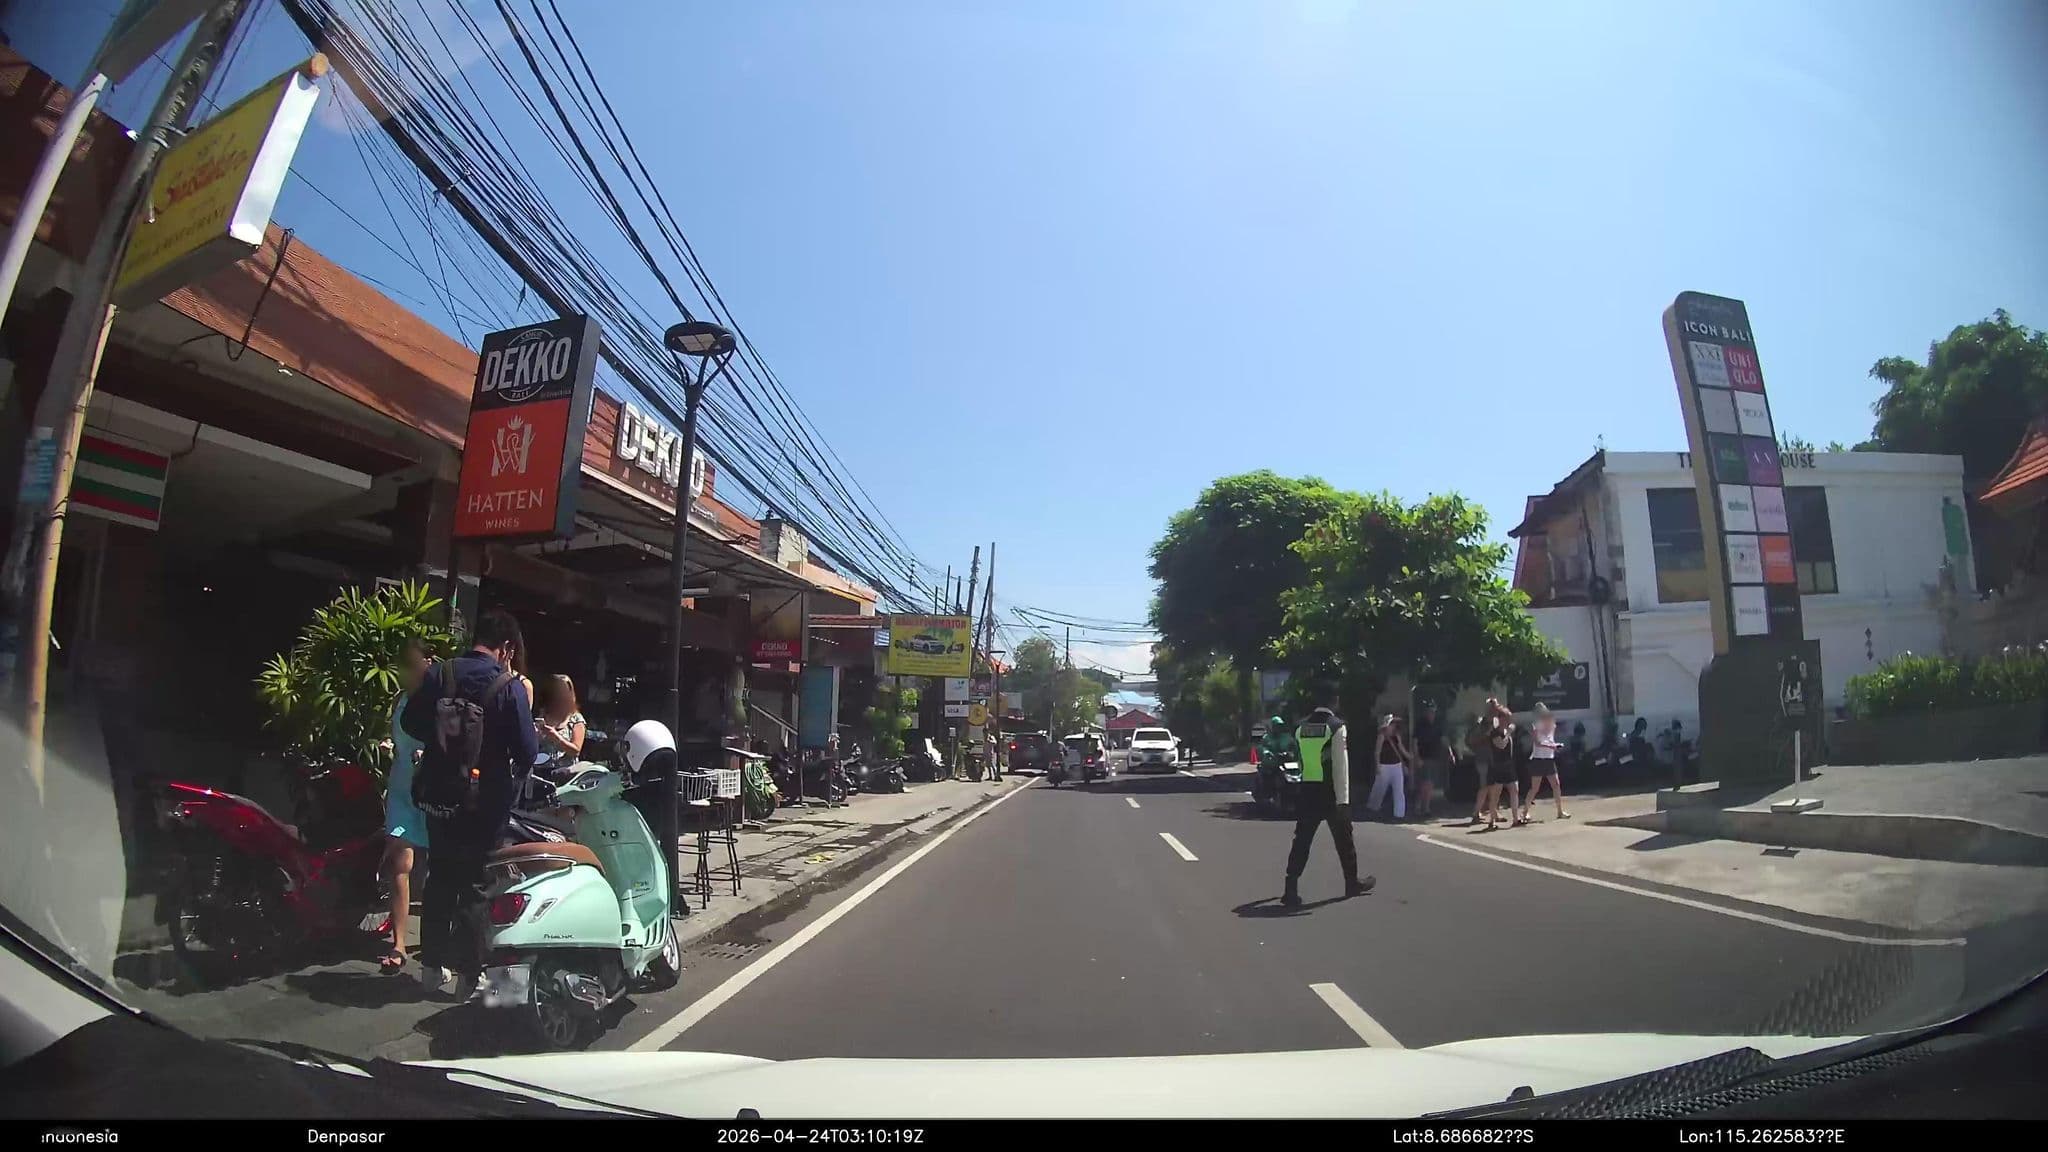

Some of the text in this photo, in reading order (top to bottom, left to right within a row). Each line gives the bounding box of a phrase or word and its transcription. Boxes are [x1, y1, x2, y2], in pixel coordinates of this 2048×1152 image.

[1684, 320, 1752, 342] ICON BALI
[481, 336, 573, 393] DEKKO
[1728, 350, 1751, 368] UNI
[1732, 369, 1758, 386] QLO
[1780, 453, 1816, 469] OUSE
[468, 488, 544, 513] HATTEN
[485, 517, 520, 530] WINES
